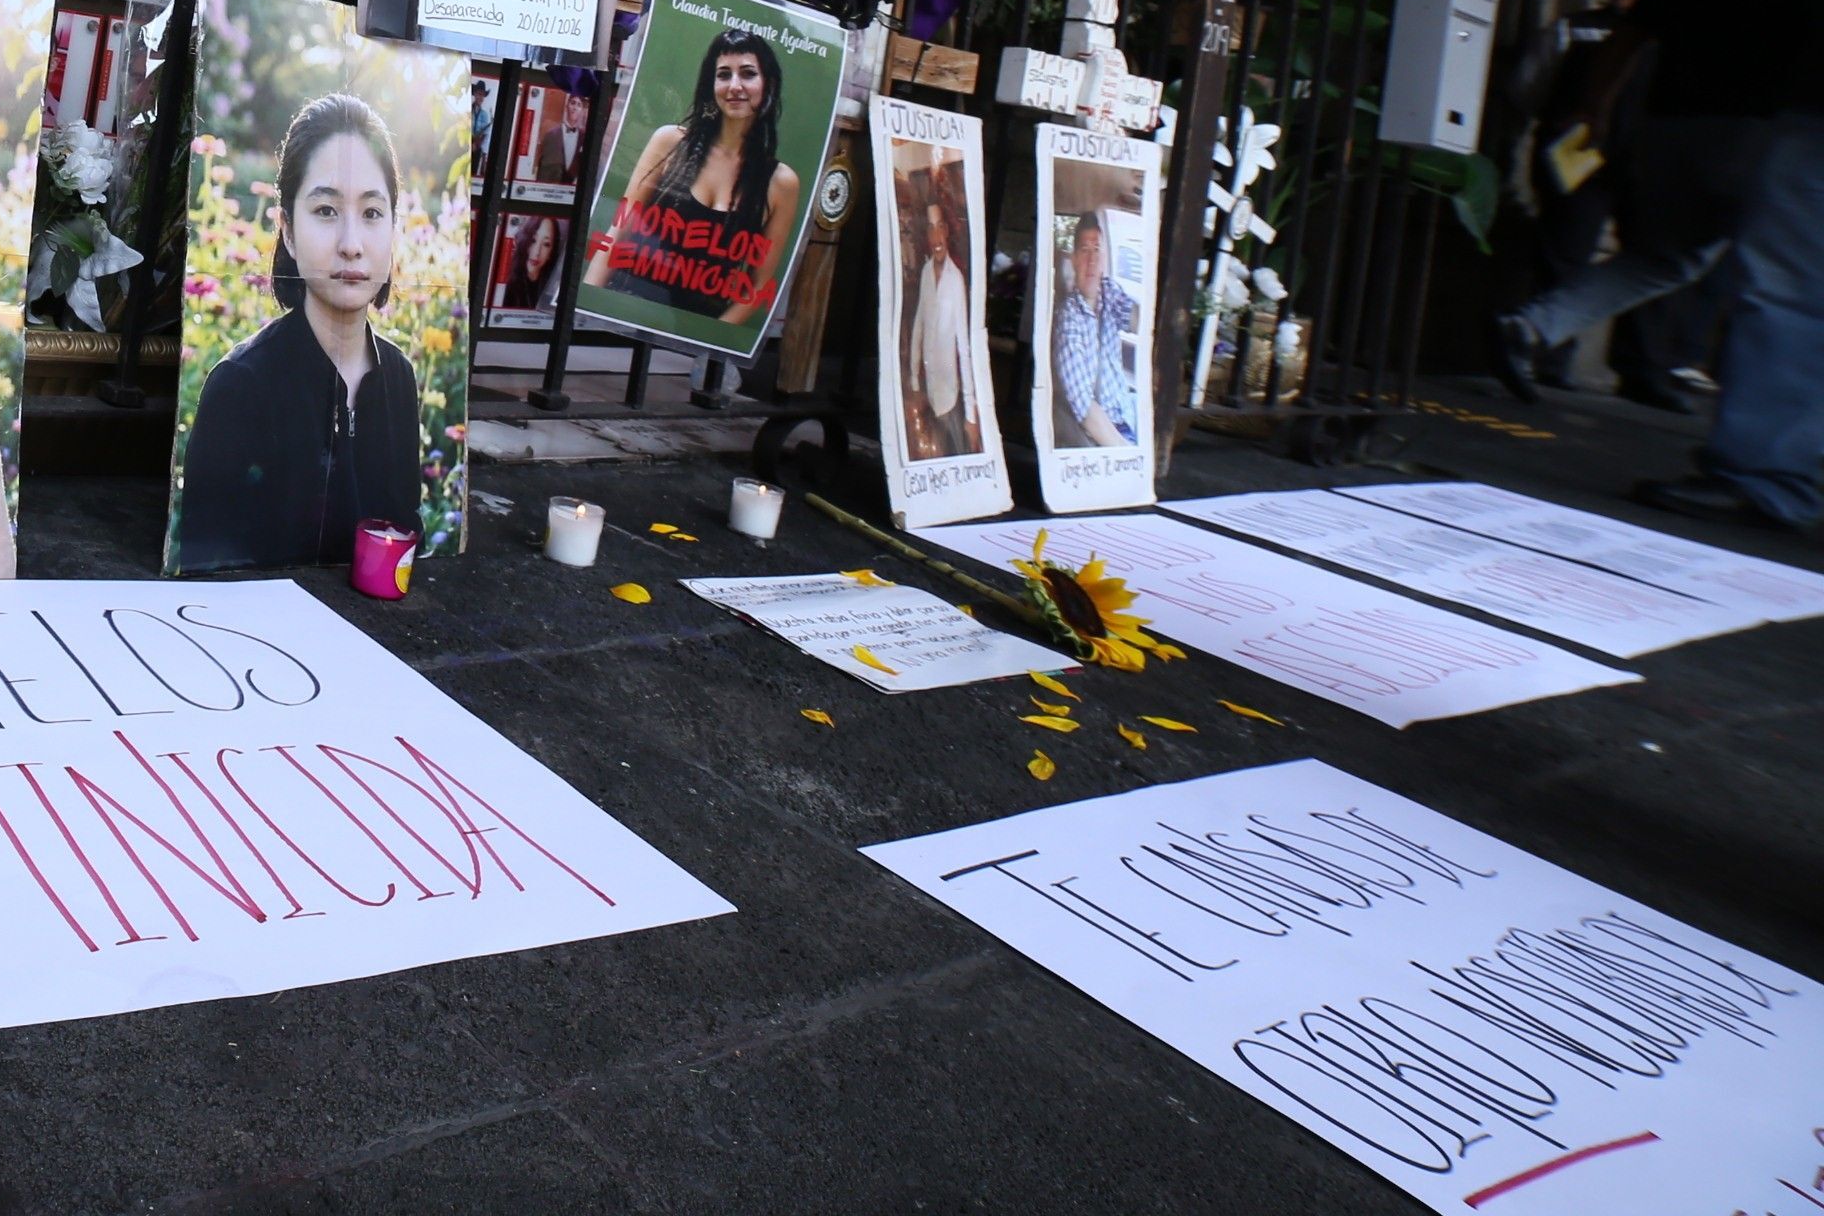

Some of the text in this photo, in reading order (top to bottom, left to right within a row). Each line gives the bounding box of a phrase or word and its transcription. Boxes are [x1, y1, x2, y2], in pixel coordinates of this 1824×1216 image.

[721, 6, 779, 42] Tacoronte
[779, 27, 828, 59] Aguilera
[1200, 21, 1231, 57] 2019
[612, 196, 774, 269] MORELOS
[1234, 605, 1539, 701] ASESINOS
[940, 848, 1240, 983] TE
